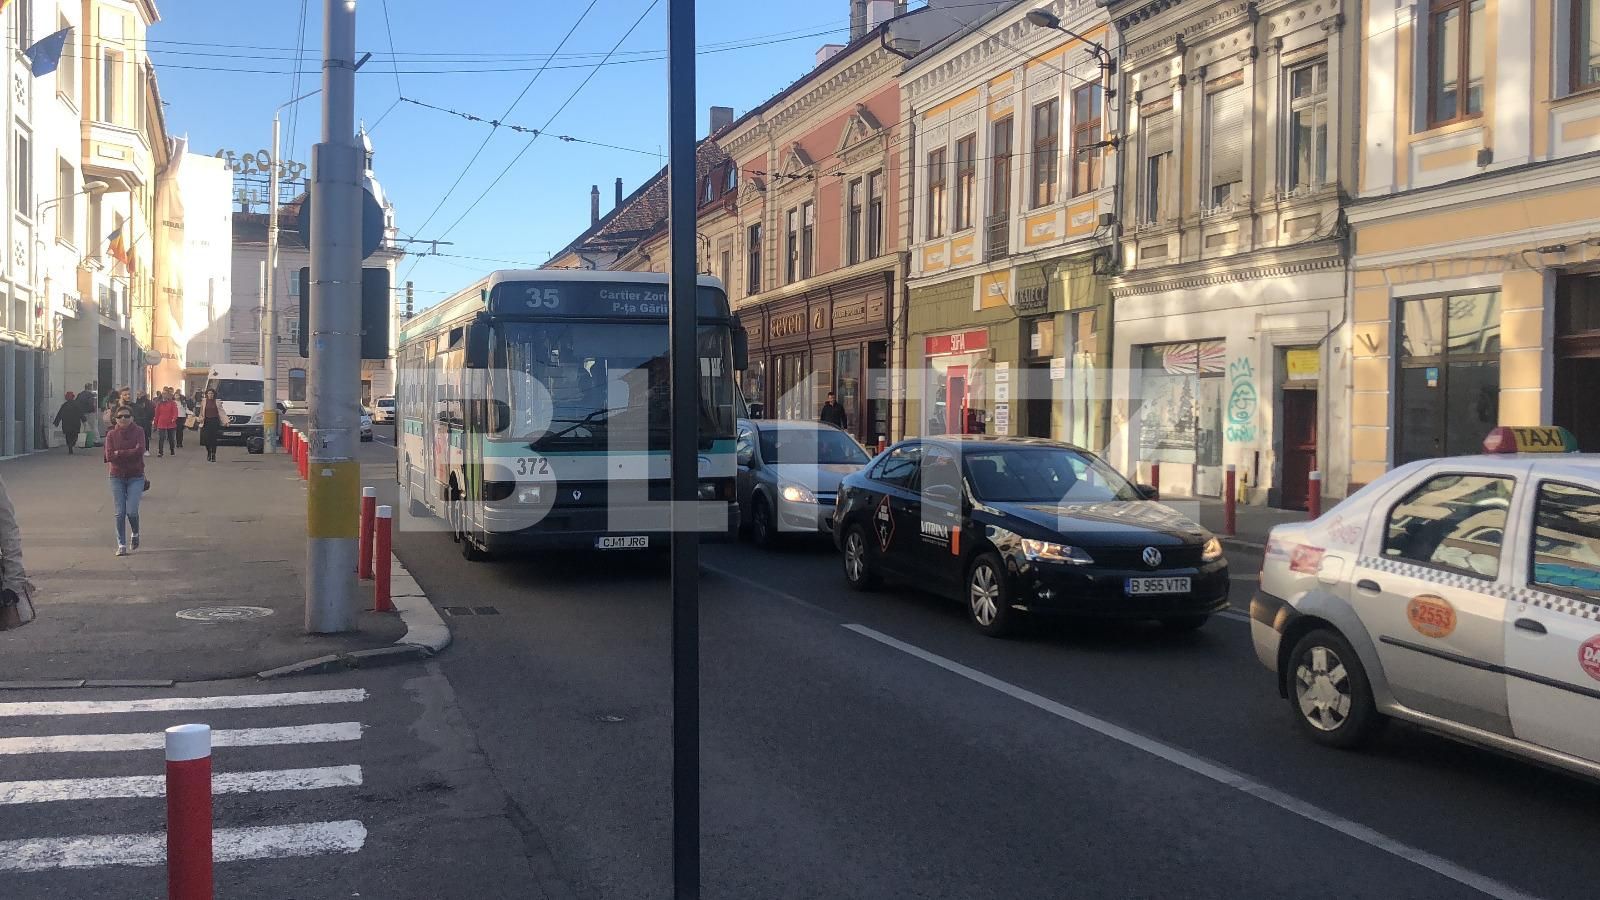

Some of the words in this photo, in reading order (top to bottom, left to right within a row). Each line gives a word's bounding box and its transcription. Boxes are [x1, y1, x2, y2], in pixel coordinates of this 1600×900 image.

[525, 287, 560, 308] 35
[599, 289, 641, 301] Cartier
[644, 290, 667, 301] Zori
[1512, 428, 1563, 447] TAXI
[517, 457, 548, 475] 372
[920, 520, 948, 539] VITRINA
[603, 538, 615, 548] CJ
[618, 537, 625, 547] 11
[628, 537, 646, 547] JRG
[1131, 580, 1140, 592] B
[1144, 579, 1164, 592] 955
[1166, 578, 1189, 591] VTR
[1418, 604, 1452, 627] 2553
